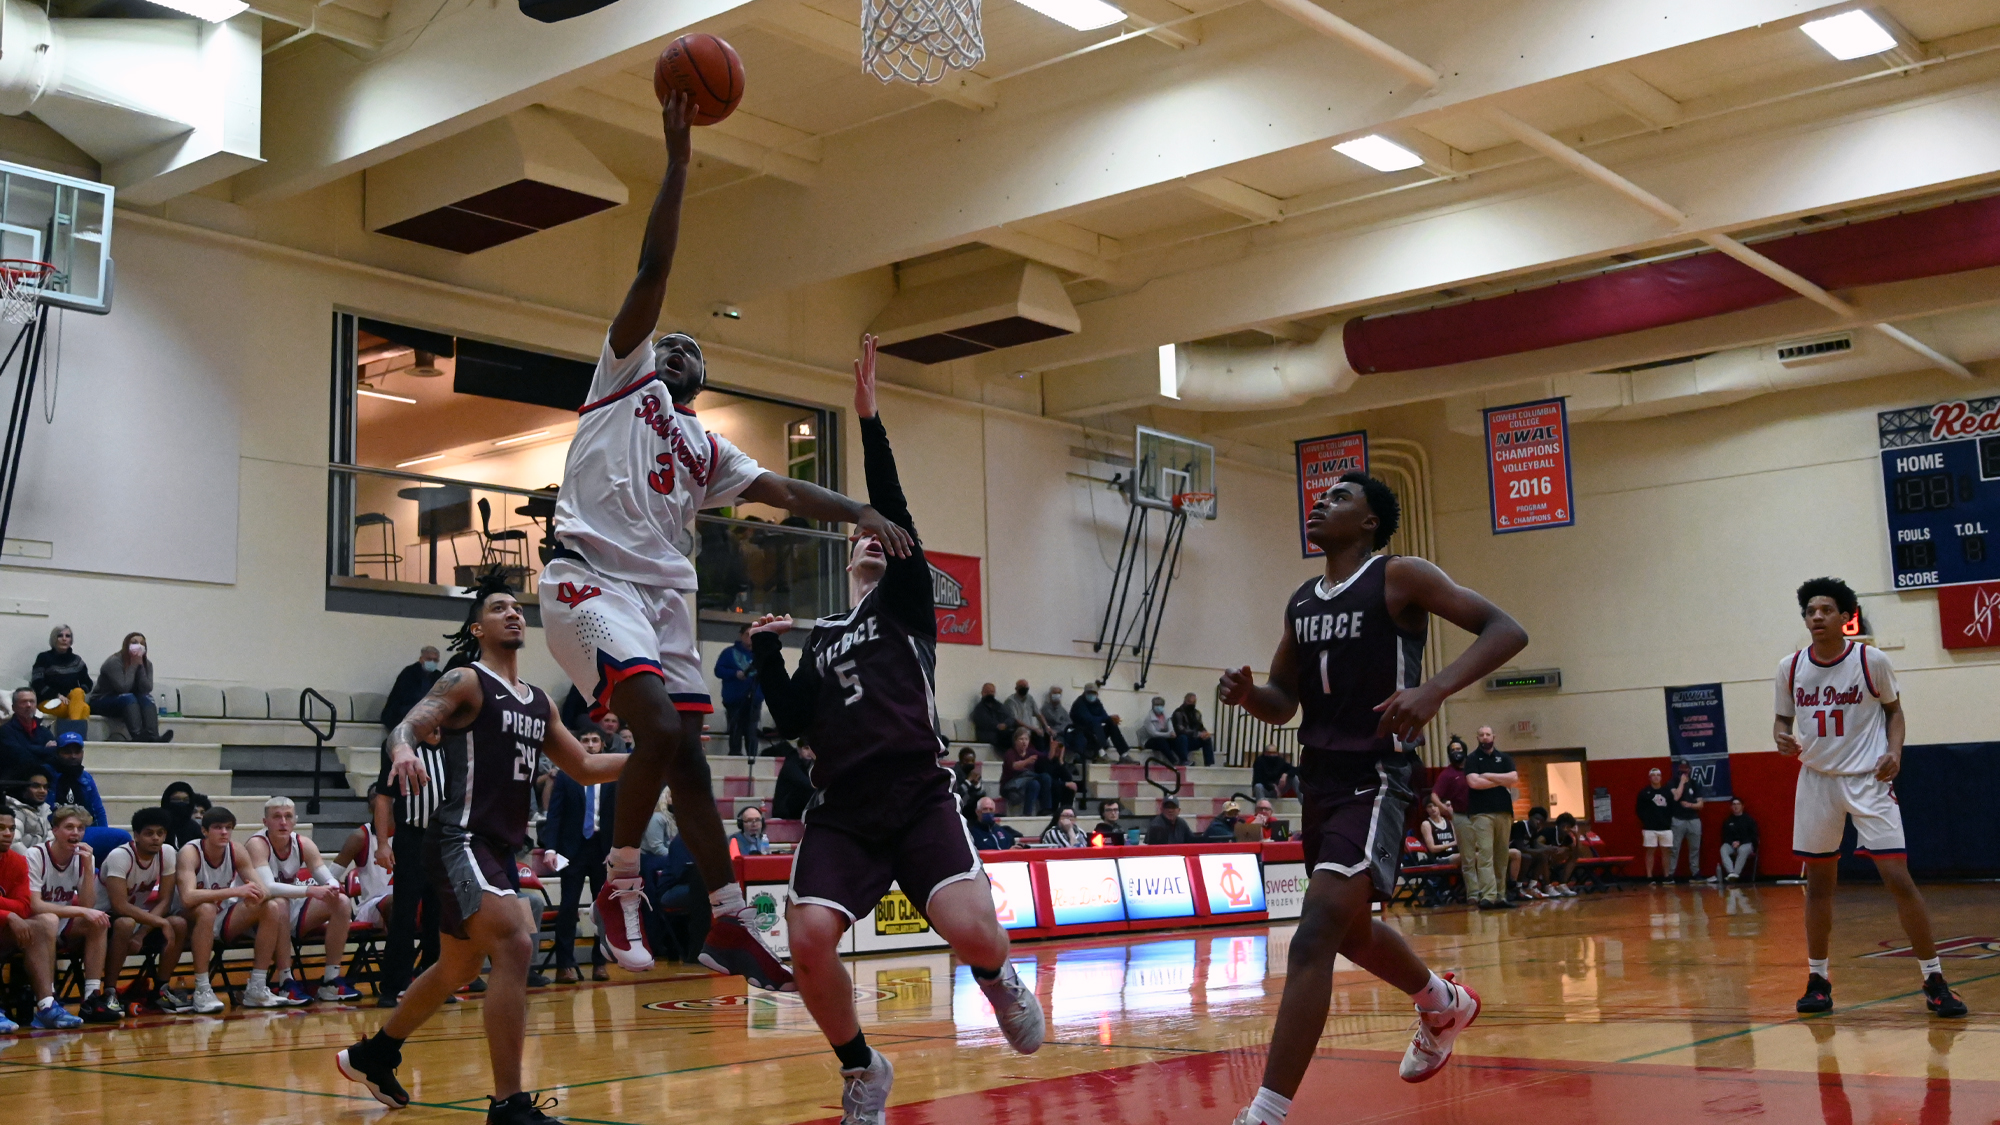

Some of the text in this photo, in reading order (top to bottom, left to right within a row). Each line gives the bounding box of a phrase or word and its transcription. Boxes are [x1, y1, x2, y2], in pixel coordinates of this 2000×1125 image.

[635, 394, 674, 440] Red
[1492, 406, 1557, 423] LOWER COLUMBIA
[1509, 417, 1540, 428] COLLEGE
[1495, 425, 1558, 447] NWAC
[1317, 448, 1345, 459] COLLEGE
[1495, 442, 1560, 462] CHAMPIONS
[648, 452, 675, 495] 3
[1305, 456, 1361, 477] NWAC
[1502, 458, 1556, 473] VOLLEYBALL
[1896, 453, 1945, 473] HOME
[1305, 475, 1340, 490] CHAMP
[1509, 476, 1552, 499] 2016
[1516, 503, 1547, 513] PROGRAM
[1897, 522, 1988, 542] FOULS T.O.L.
[1897, 571, 1940, 586] SCORE
[1295, 610, 1365, 644] PIERCE
[1319, 649, 1332, 694] 1
[834, 659, 864, 707] 5
[1796, 684, 1864, 707] Red Devils
[501, 710, 546, 742] PIERCE
[1518, 720, 1531, 732] EXIT
[1812, 709, 1844, 738] 11
[513, 741, 537, 783] 24
[876, 900, 895, 921] BUD
